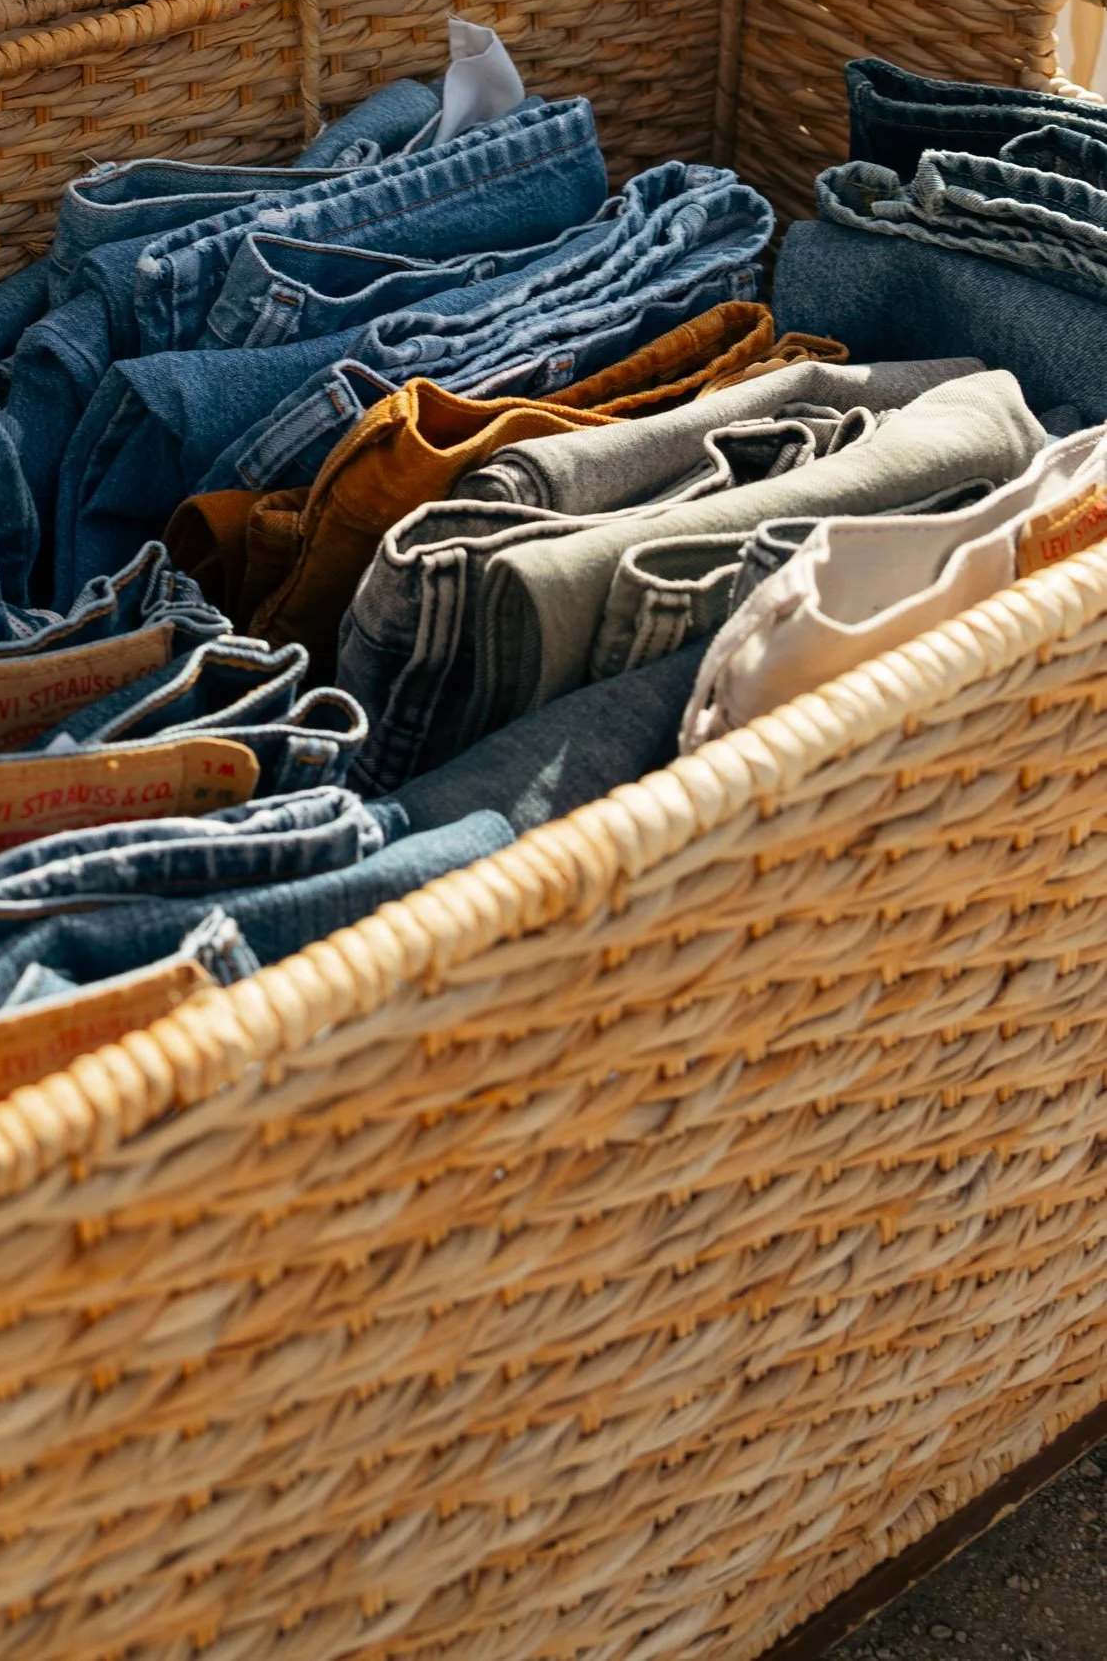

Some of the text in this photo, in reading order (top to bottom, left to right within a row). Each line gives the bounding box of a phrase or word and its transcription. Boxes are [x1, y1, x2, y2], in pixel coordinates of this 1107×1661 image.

[27, 674, 116, 713] STRAUSS
[21, 781, 118, 819] STRAUSS
[122, 785, 135, 807] &
[141, 781, 174, 803] CO.
